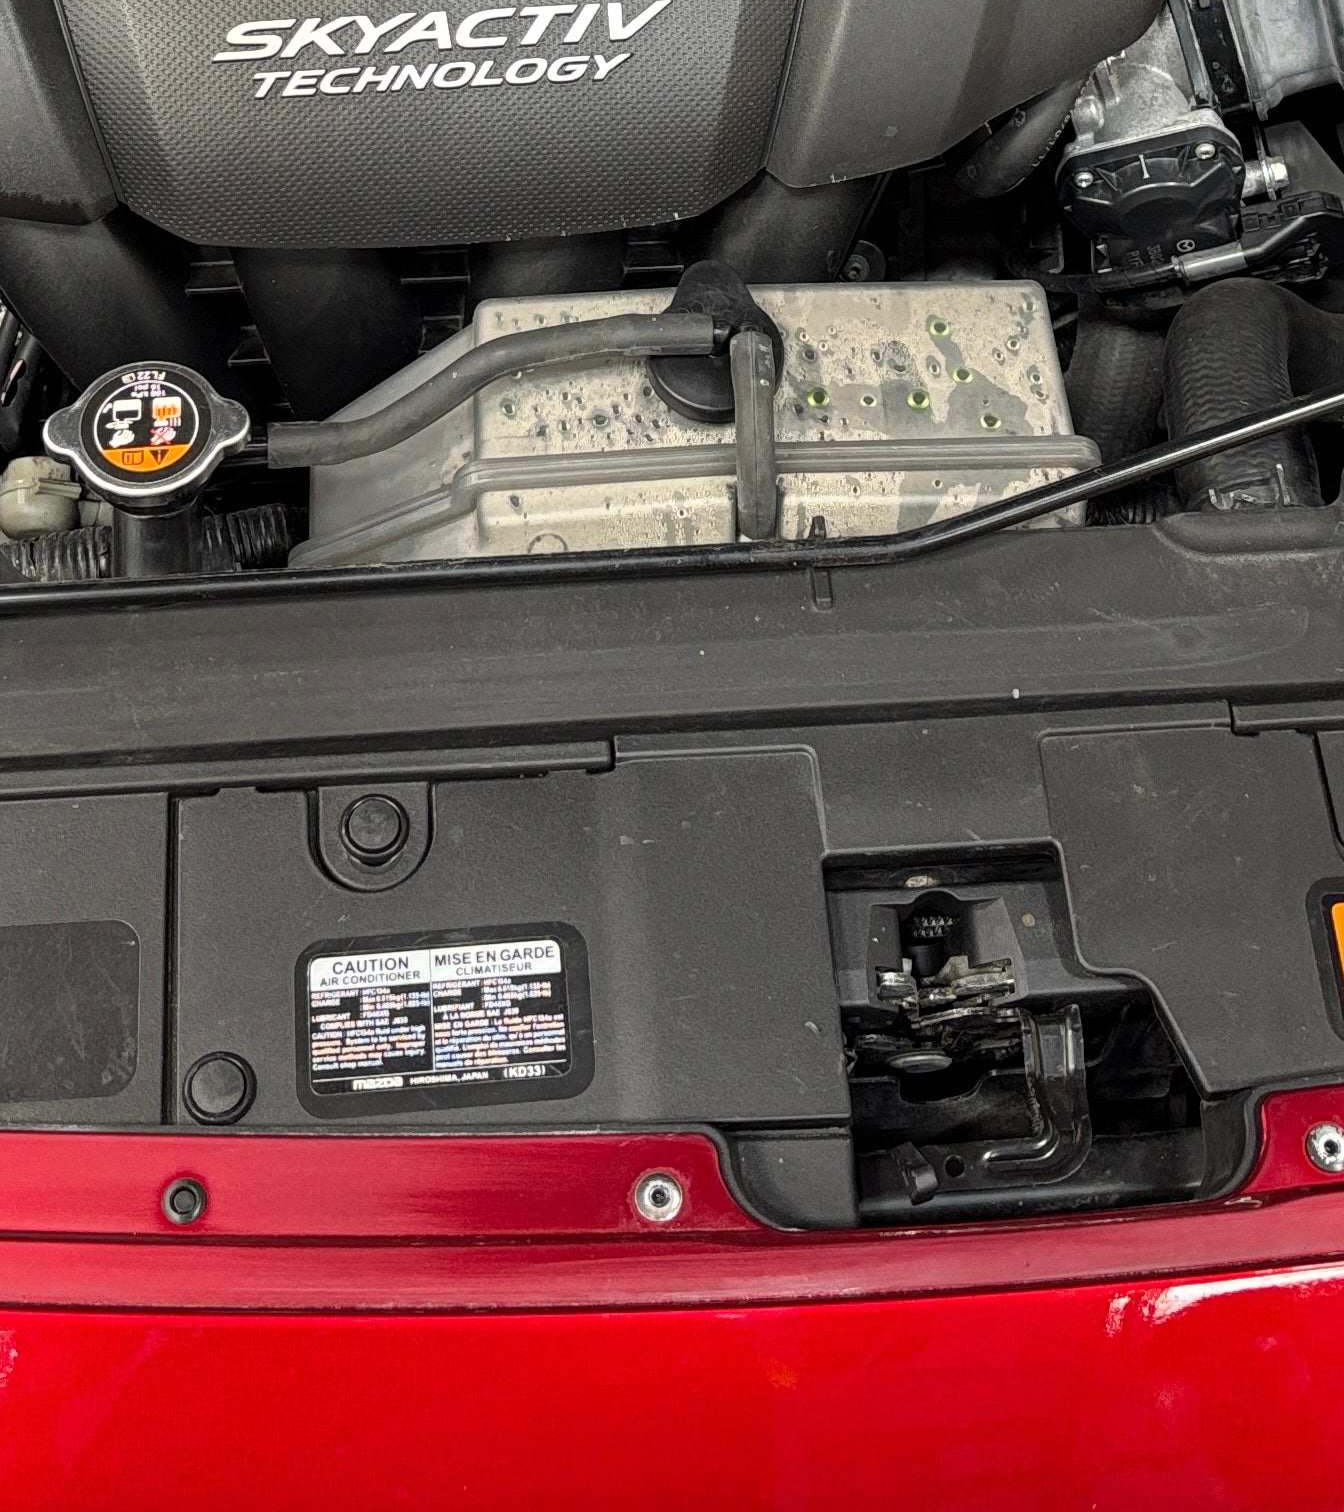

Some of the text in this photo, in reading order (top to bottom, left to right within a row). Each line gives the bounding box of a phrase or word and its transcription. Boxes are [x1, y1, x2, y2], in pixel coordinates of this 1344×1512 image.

[212, 0, 672, 63] SKYACTIV
[253, 53, 633, 99] TECHNOLOGY
[136, 370, 166, 381] FL22
[332, 956, 409, 975] CAUTION
[434, 946, 555, 967] MISE EN GARDE
[320, 970, 421, 987] AIR CONDITIONER
[456, 961, 533, 976] CLIMATISEUR
[352, 1076, 404, 1091] mazda
[461, 1071, 489, 1080] JAPAN
[503, 1065, 546, 1079] (KD33)
